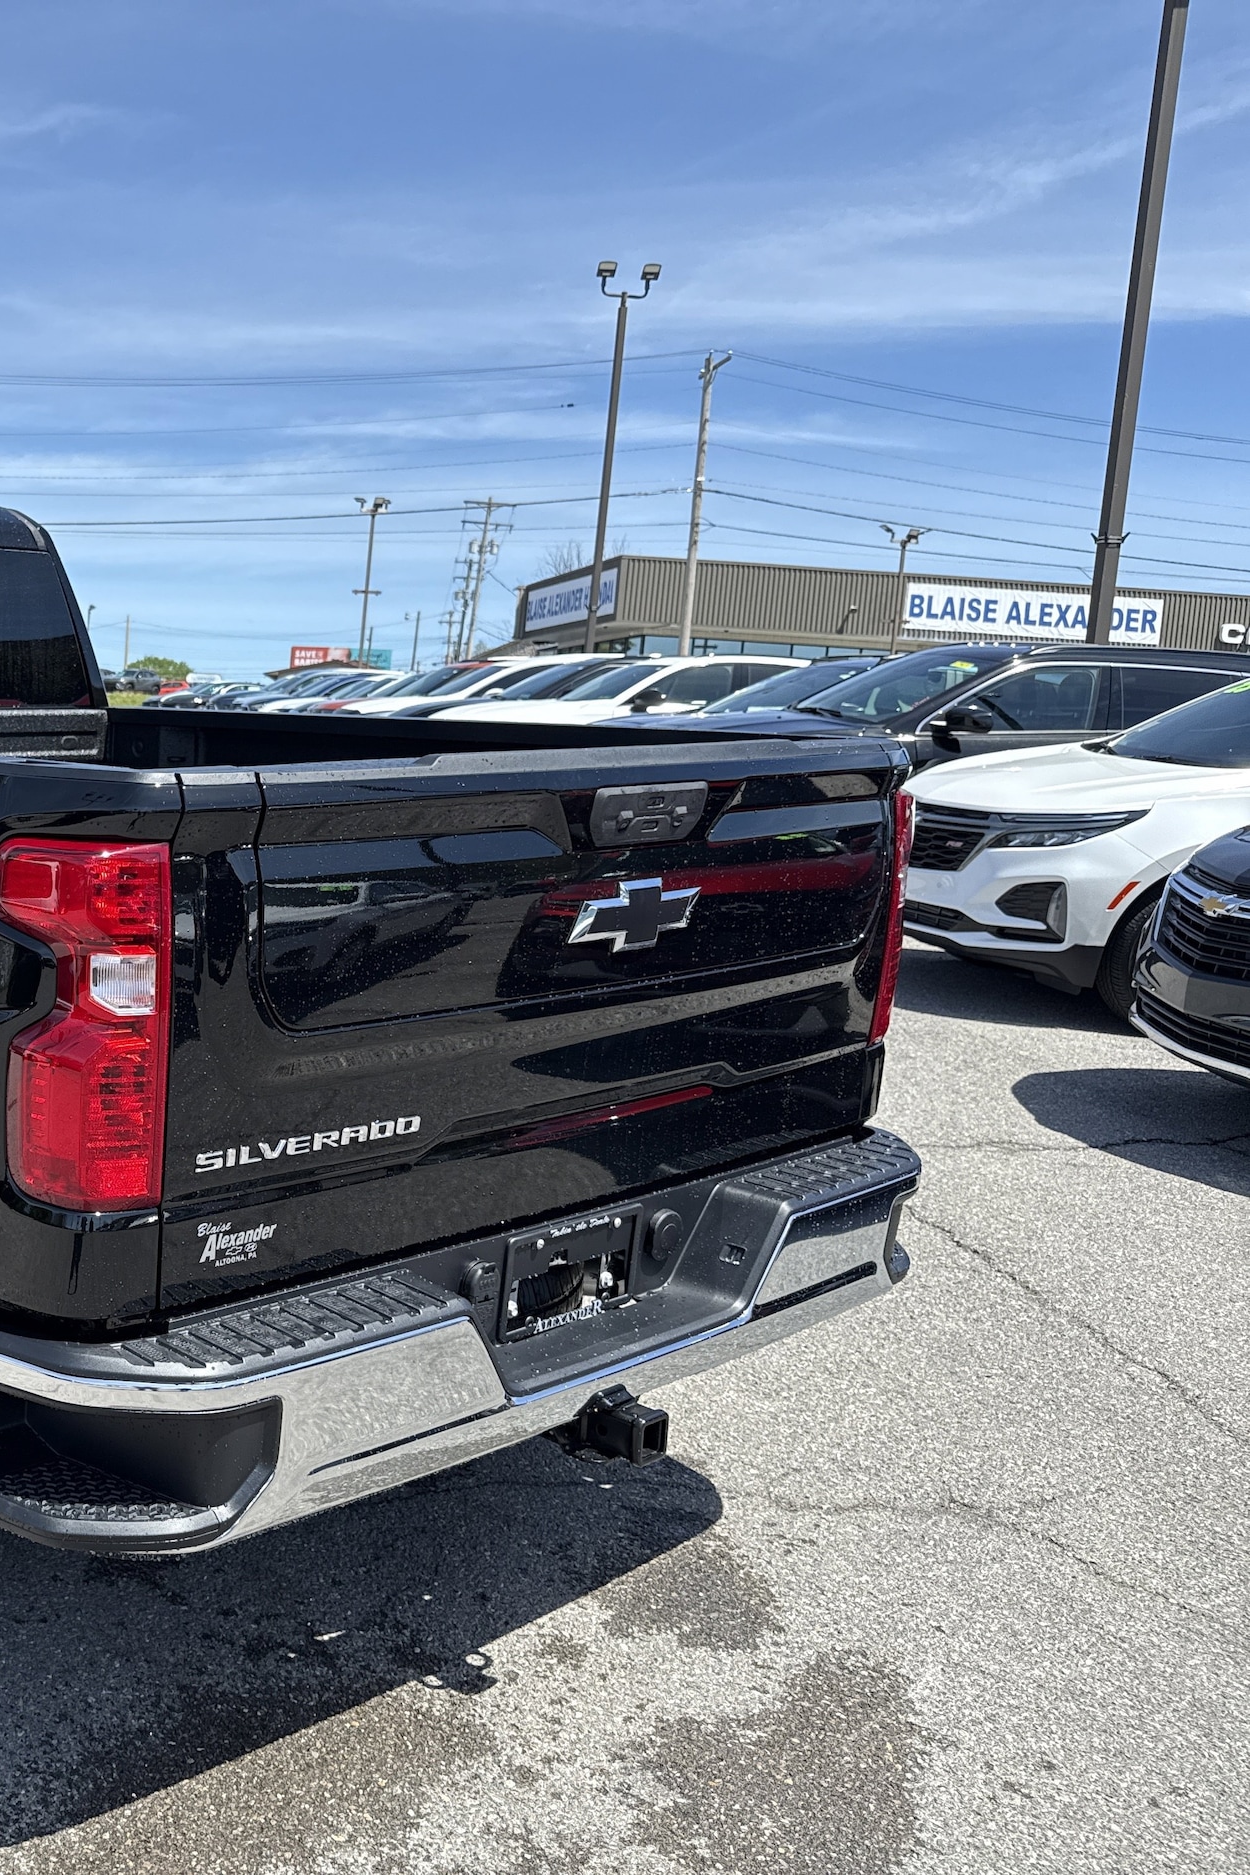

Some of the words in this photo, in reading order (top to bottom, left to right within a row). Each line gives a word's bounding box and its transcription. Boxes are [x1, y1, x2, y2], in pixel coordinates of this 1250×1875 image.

[547, 587, 584, 617] ALEXANDER
[908, 594, 999, 624] BLAISE
[1005, 600, 1158, 634] ALEXADER
[294, 649, 317, 659] SAVE
[195, 1115, 422, 1173] SILVERADO
[197, 1221, 232, 1238] Blaise
[199, 1223, 277, 1263] Alexander
[214, 1254, 247, 1267] ALTOONA,
[247, 1252, 257, 1260] PA
[533, 1299, 603, 1334] ALEXANDER
